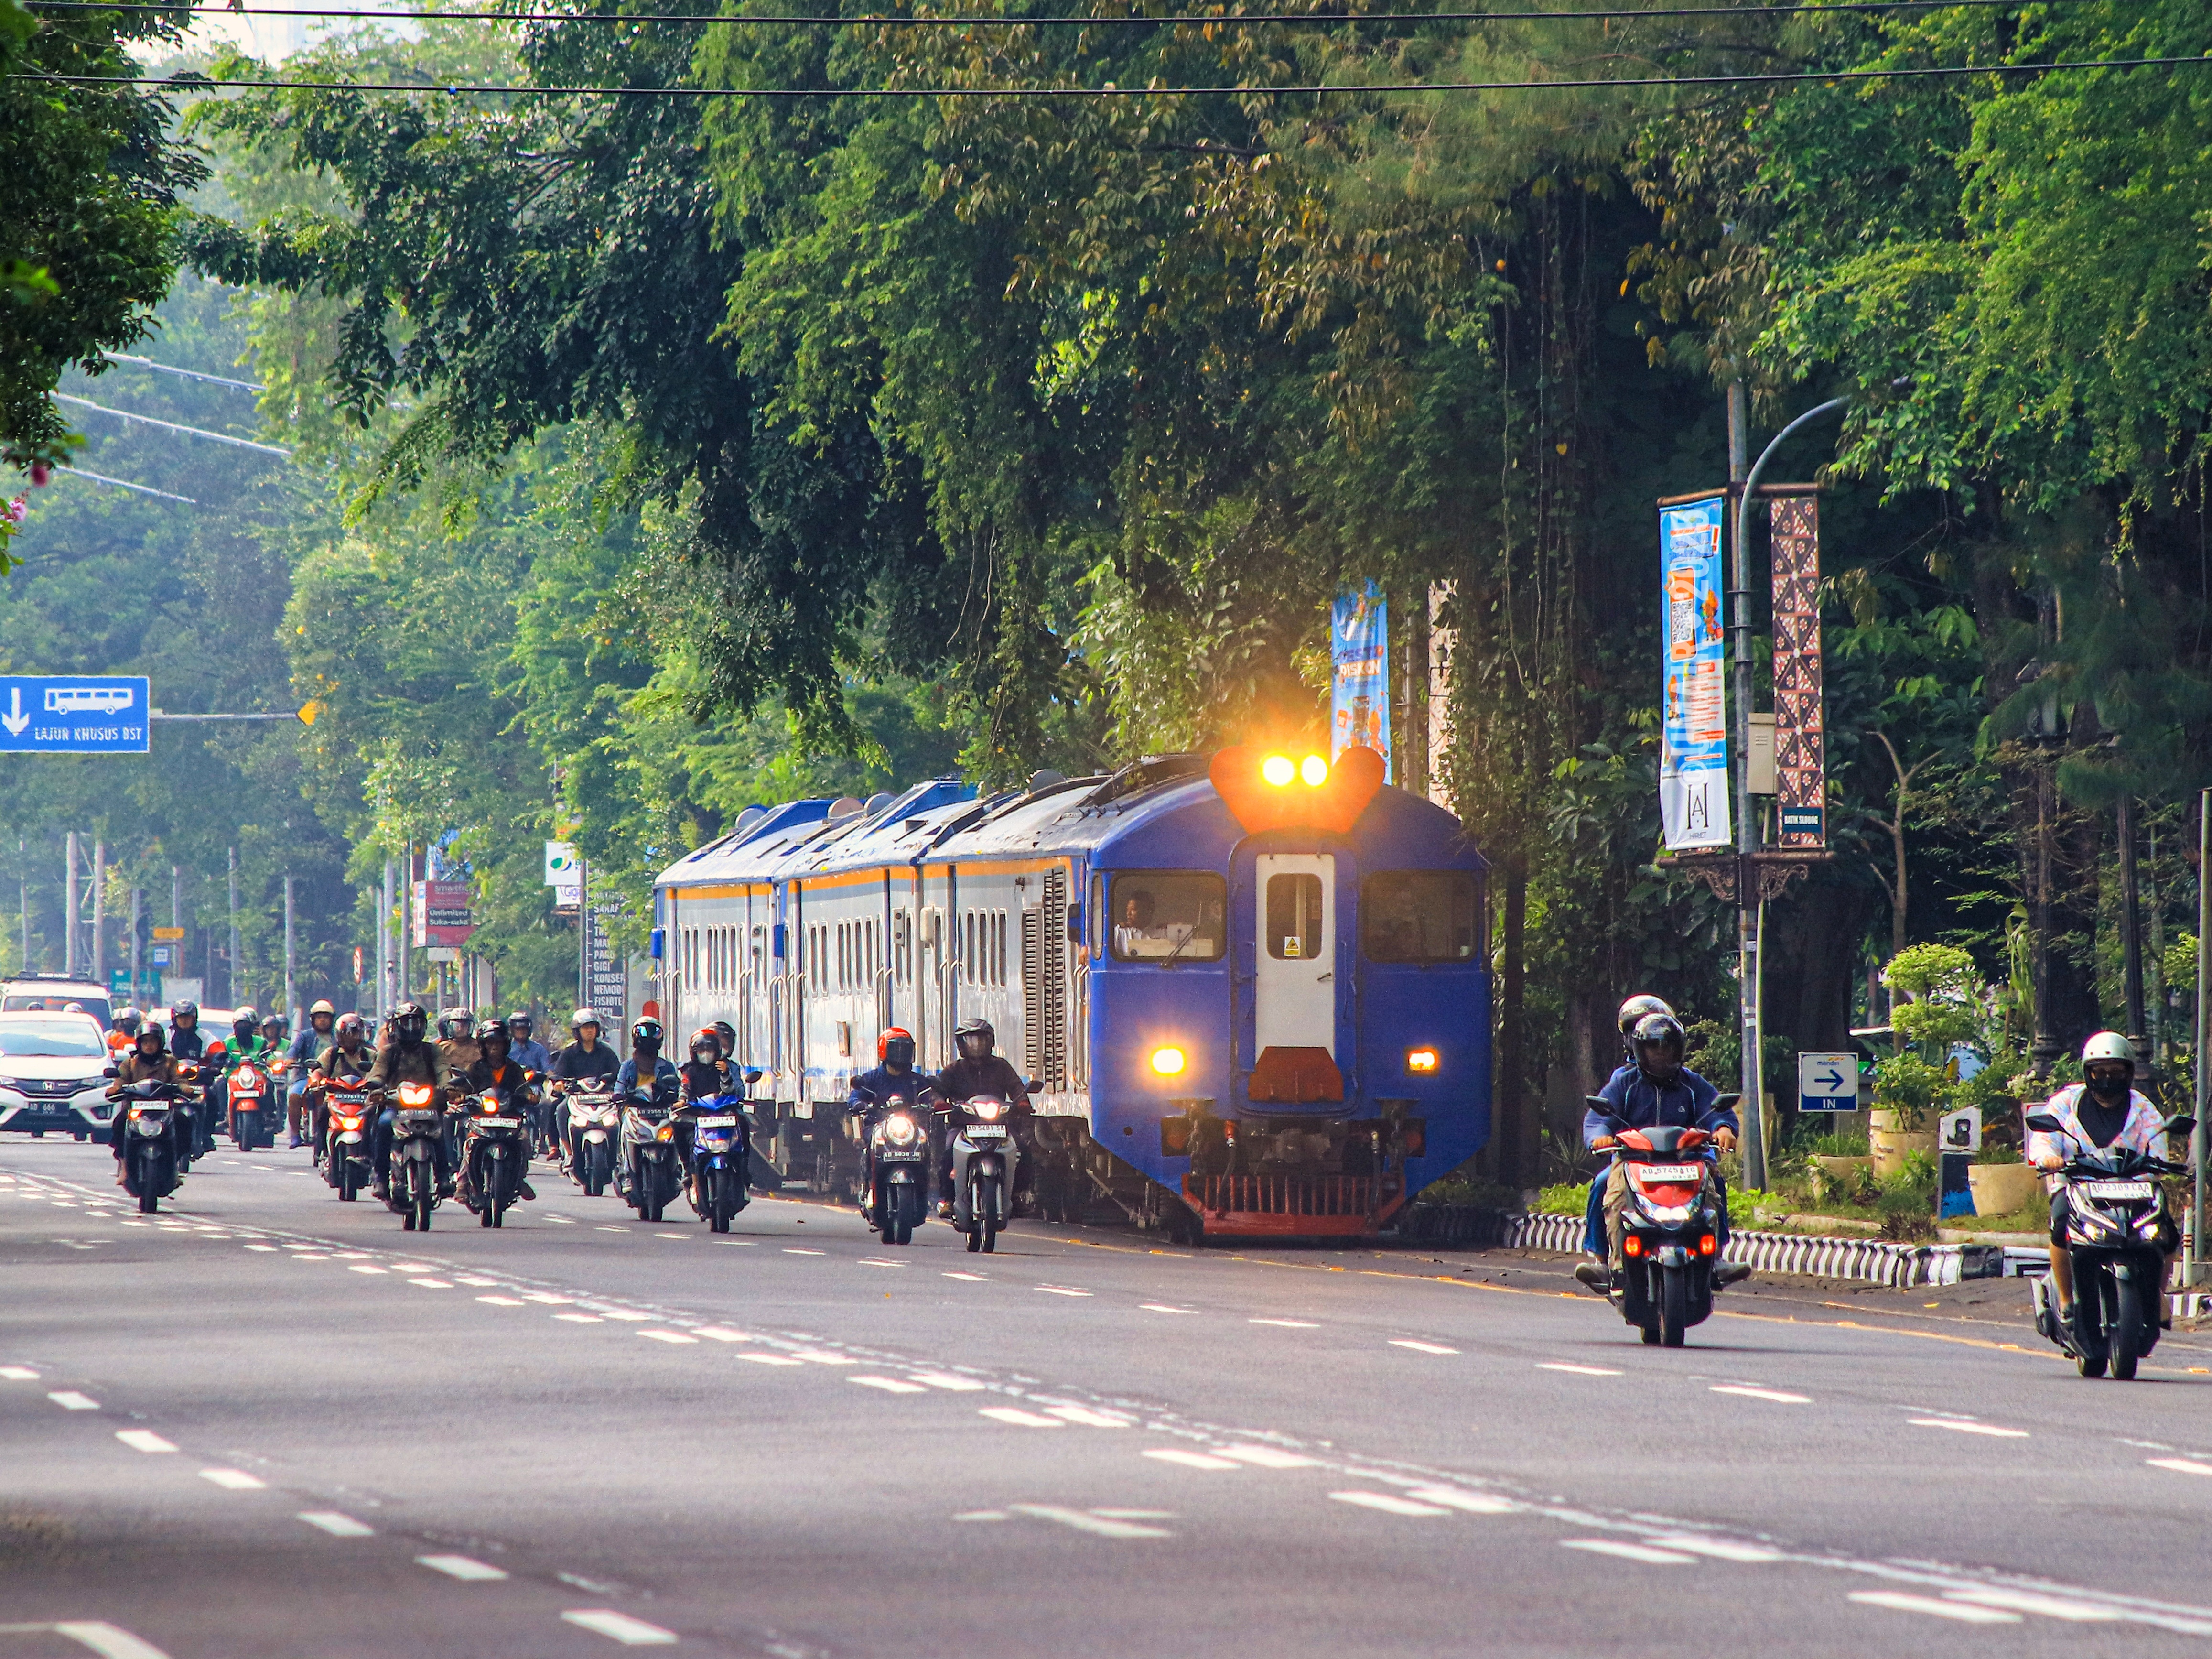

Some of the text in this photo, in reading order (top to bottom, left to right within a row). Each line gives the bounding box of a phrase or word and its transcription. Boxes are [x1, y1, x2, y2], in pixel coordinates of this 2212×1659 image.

[1340, 659, 1381, 677] DISKON
[35, 727, 142, 740] LAJUR KHUSUS BST
[594, 962, 610, 971] GIGI
[1823, 1099, 1835, 1109] IN
